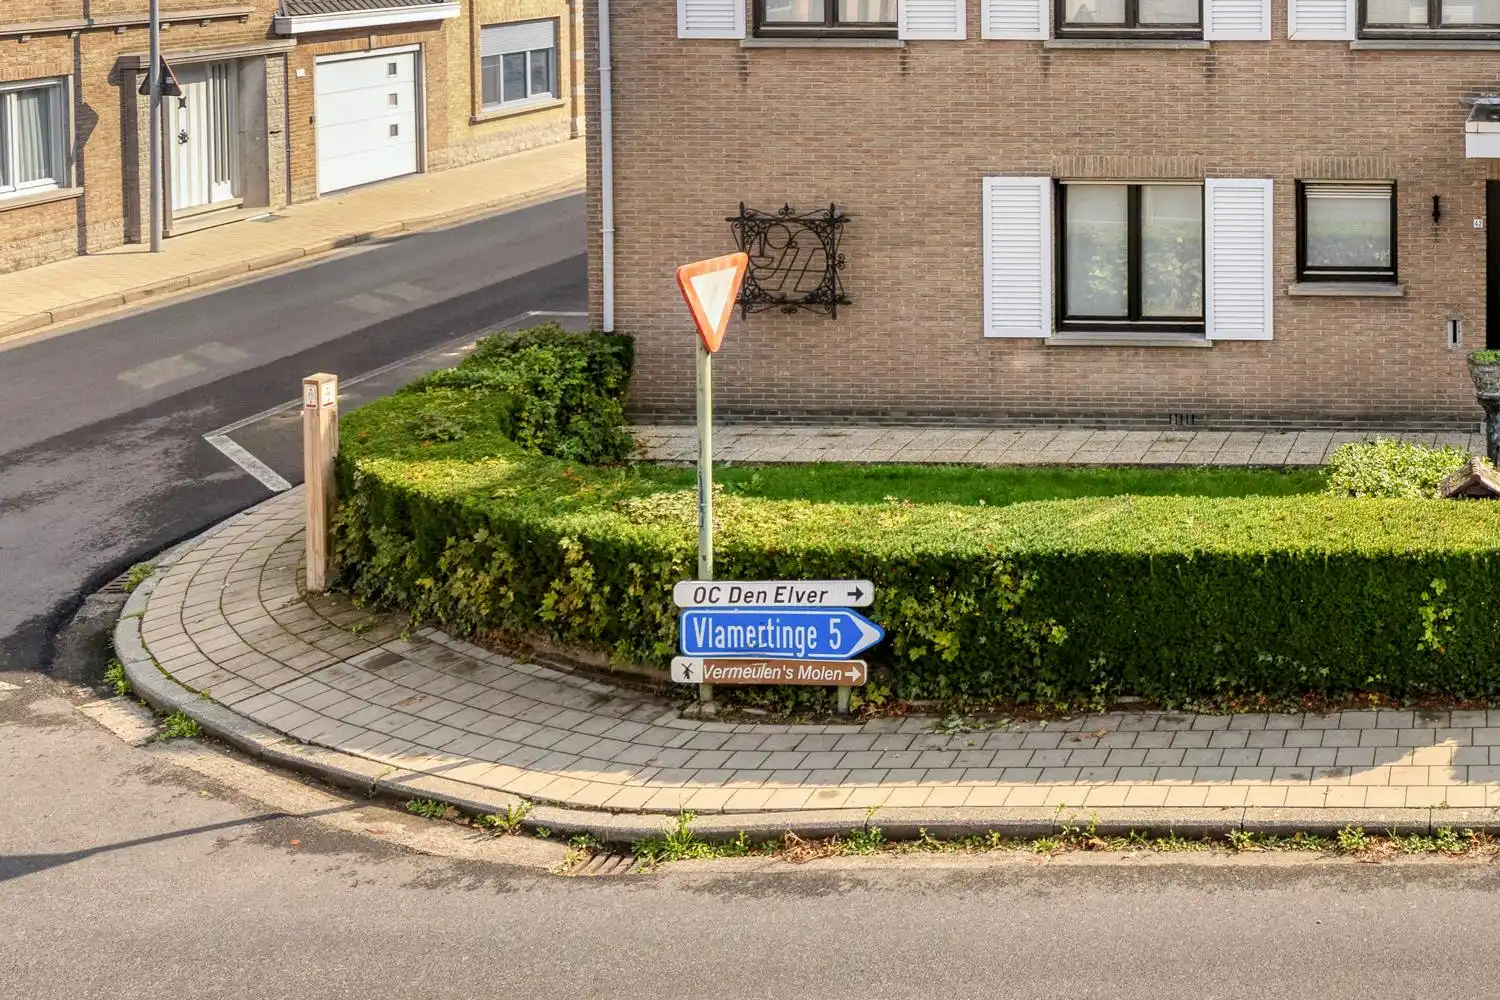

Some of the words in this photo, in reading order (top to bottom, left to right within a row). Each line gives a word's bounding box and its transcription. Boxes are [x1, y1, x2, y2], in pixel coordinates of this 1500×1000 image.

[693, 586, 722, 604] OC
[728, 586, 768, 604] Den
[774, 586, 829, 604] Elver
[692, 616, 818, 657] Vlamertinge
[829, 618, 842, 650] 5
[703, 663, 794, 681] Vermeulen's
[797, 664, 843, 681] Molen
